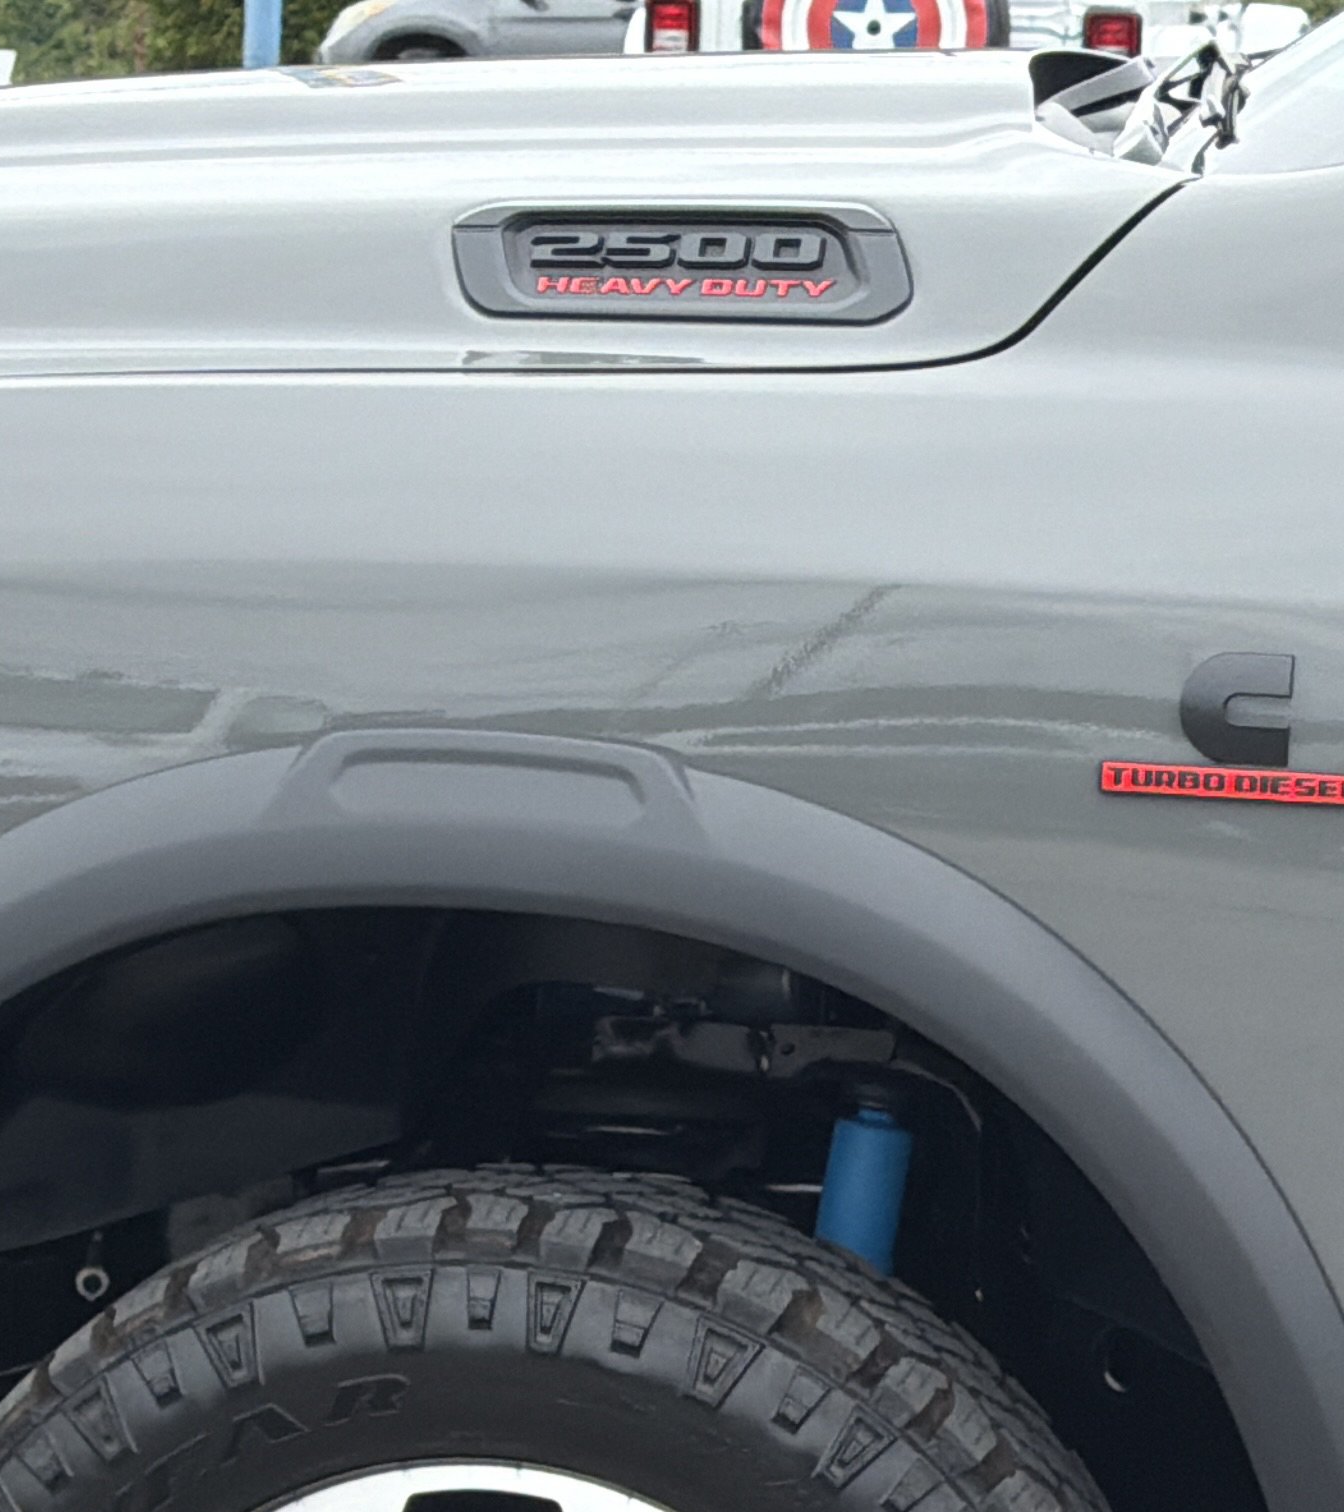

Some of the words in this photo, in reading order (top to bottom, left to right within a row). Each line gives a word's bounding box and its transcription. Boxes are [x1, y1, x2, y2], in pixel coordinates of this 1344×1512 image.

[530, 232, 826, 270] 2500
[536, 276, 693, 296] HEAVY
[701, 278, 836, 297] DUTY
[1109, 766, 1225, 792] TURBO
